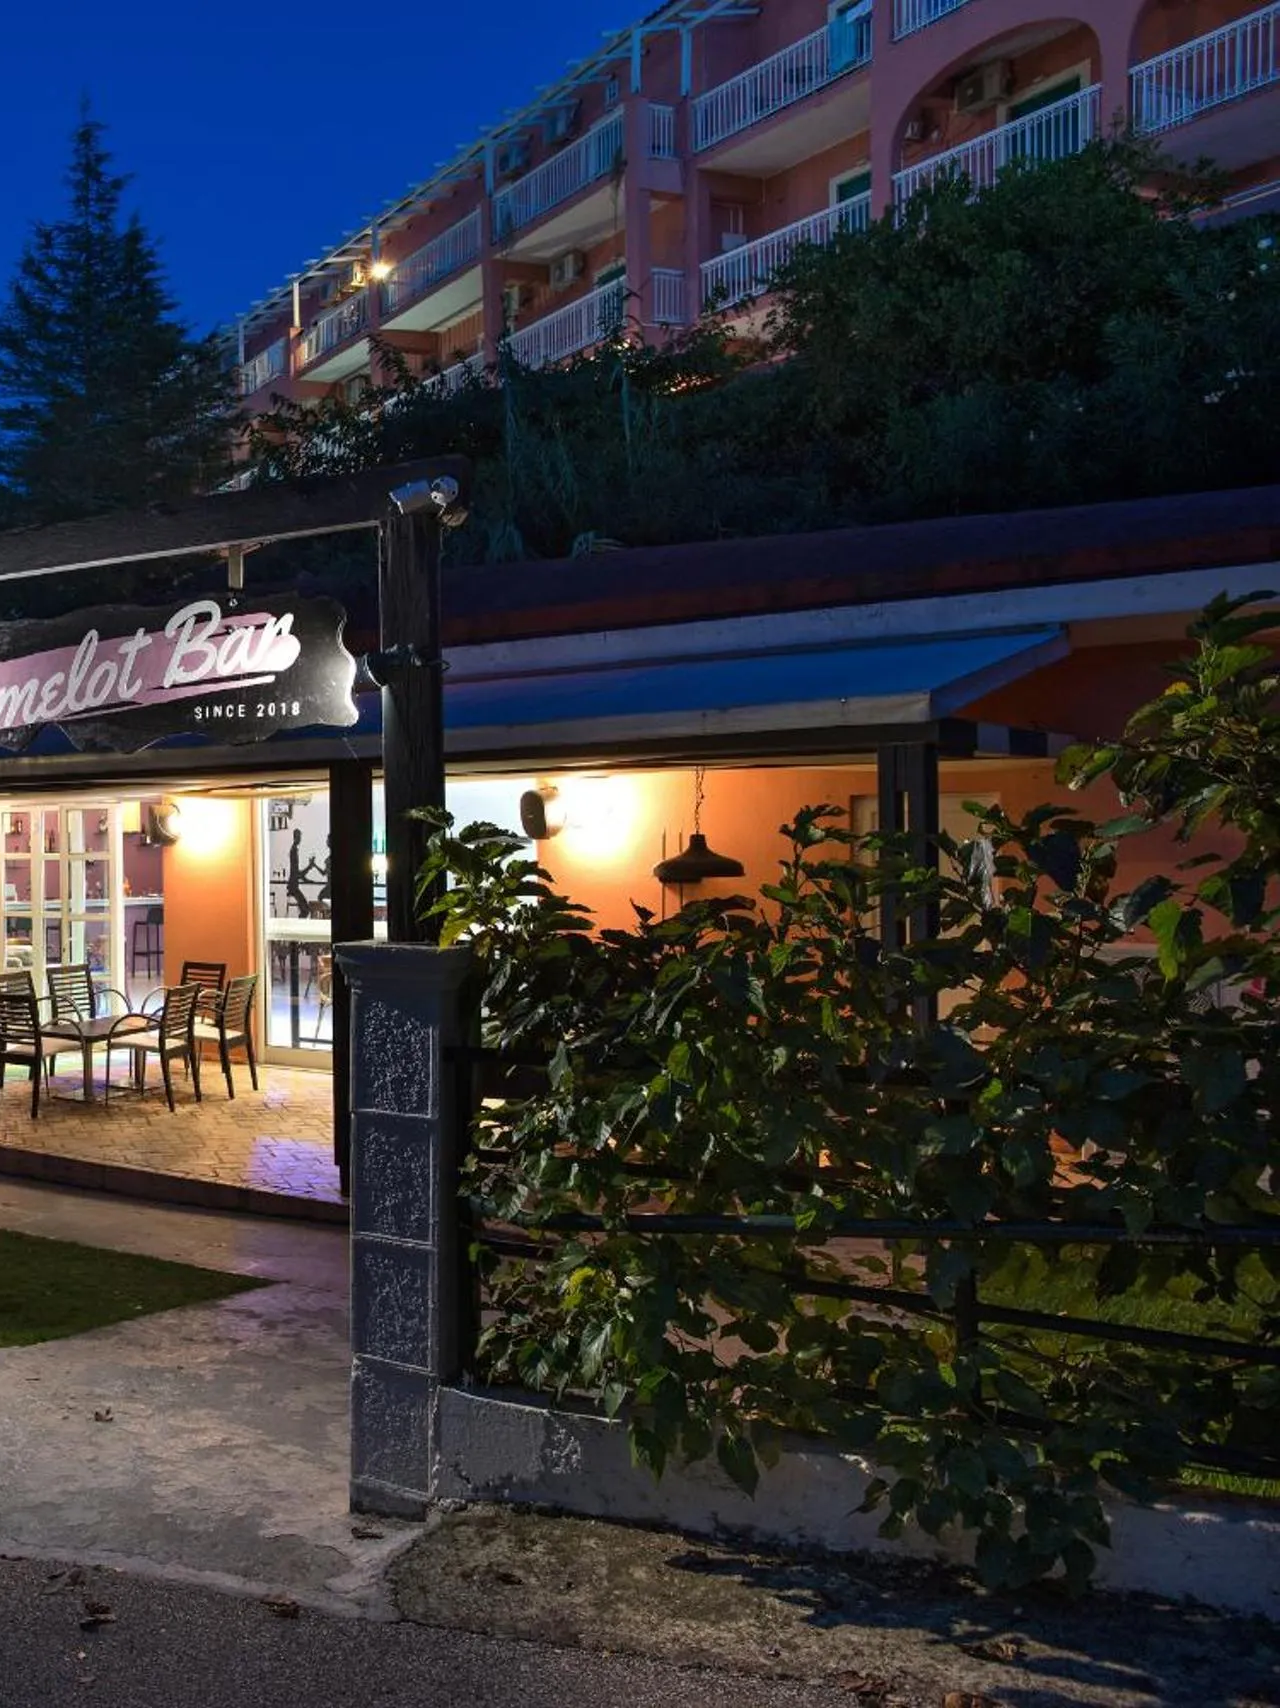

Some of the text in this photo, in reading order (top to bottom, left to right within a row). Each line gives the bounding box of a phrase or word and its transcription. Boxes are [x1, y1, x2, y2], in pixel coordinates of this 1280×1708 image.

[163, 600, 296, 688] Bar
[194, 701, 301, 720] SINCE 2018
